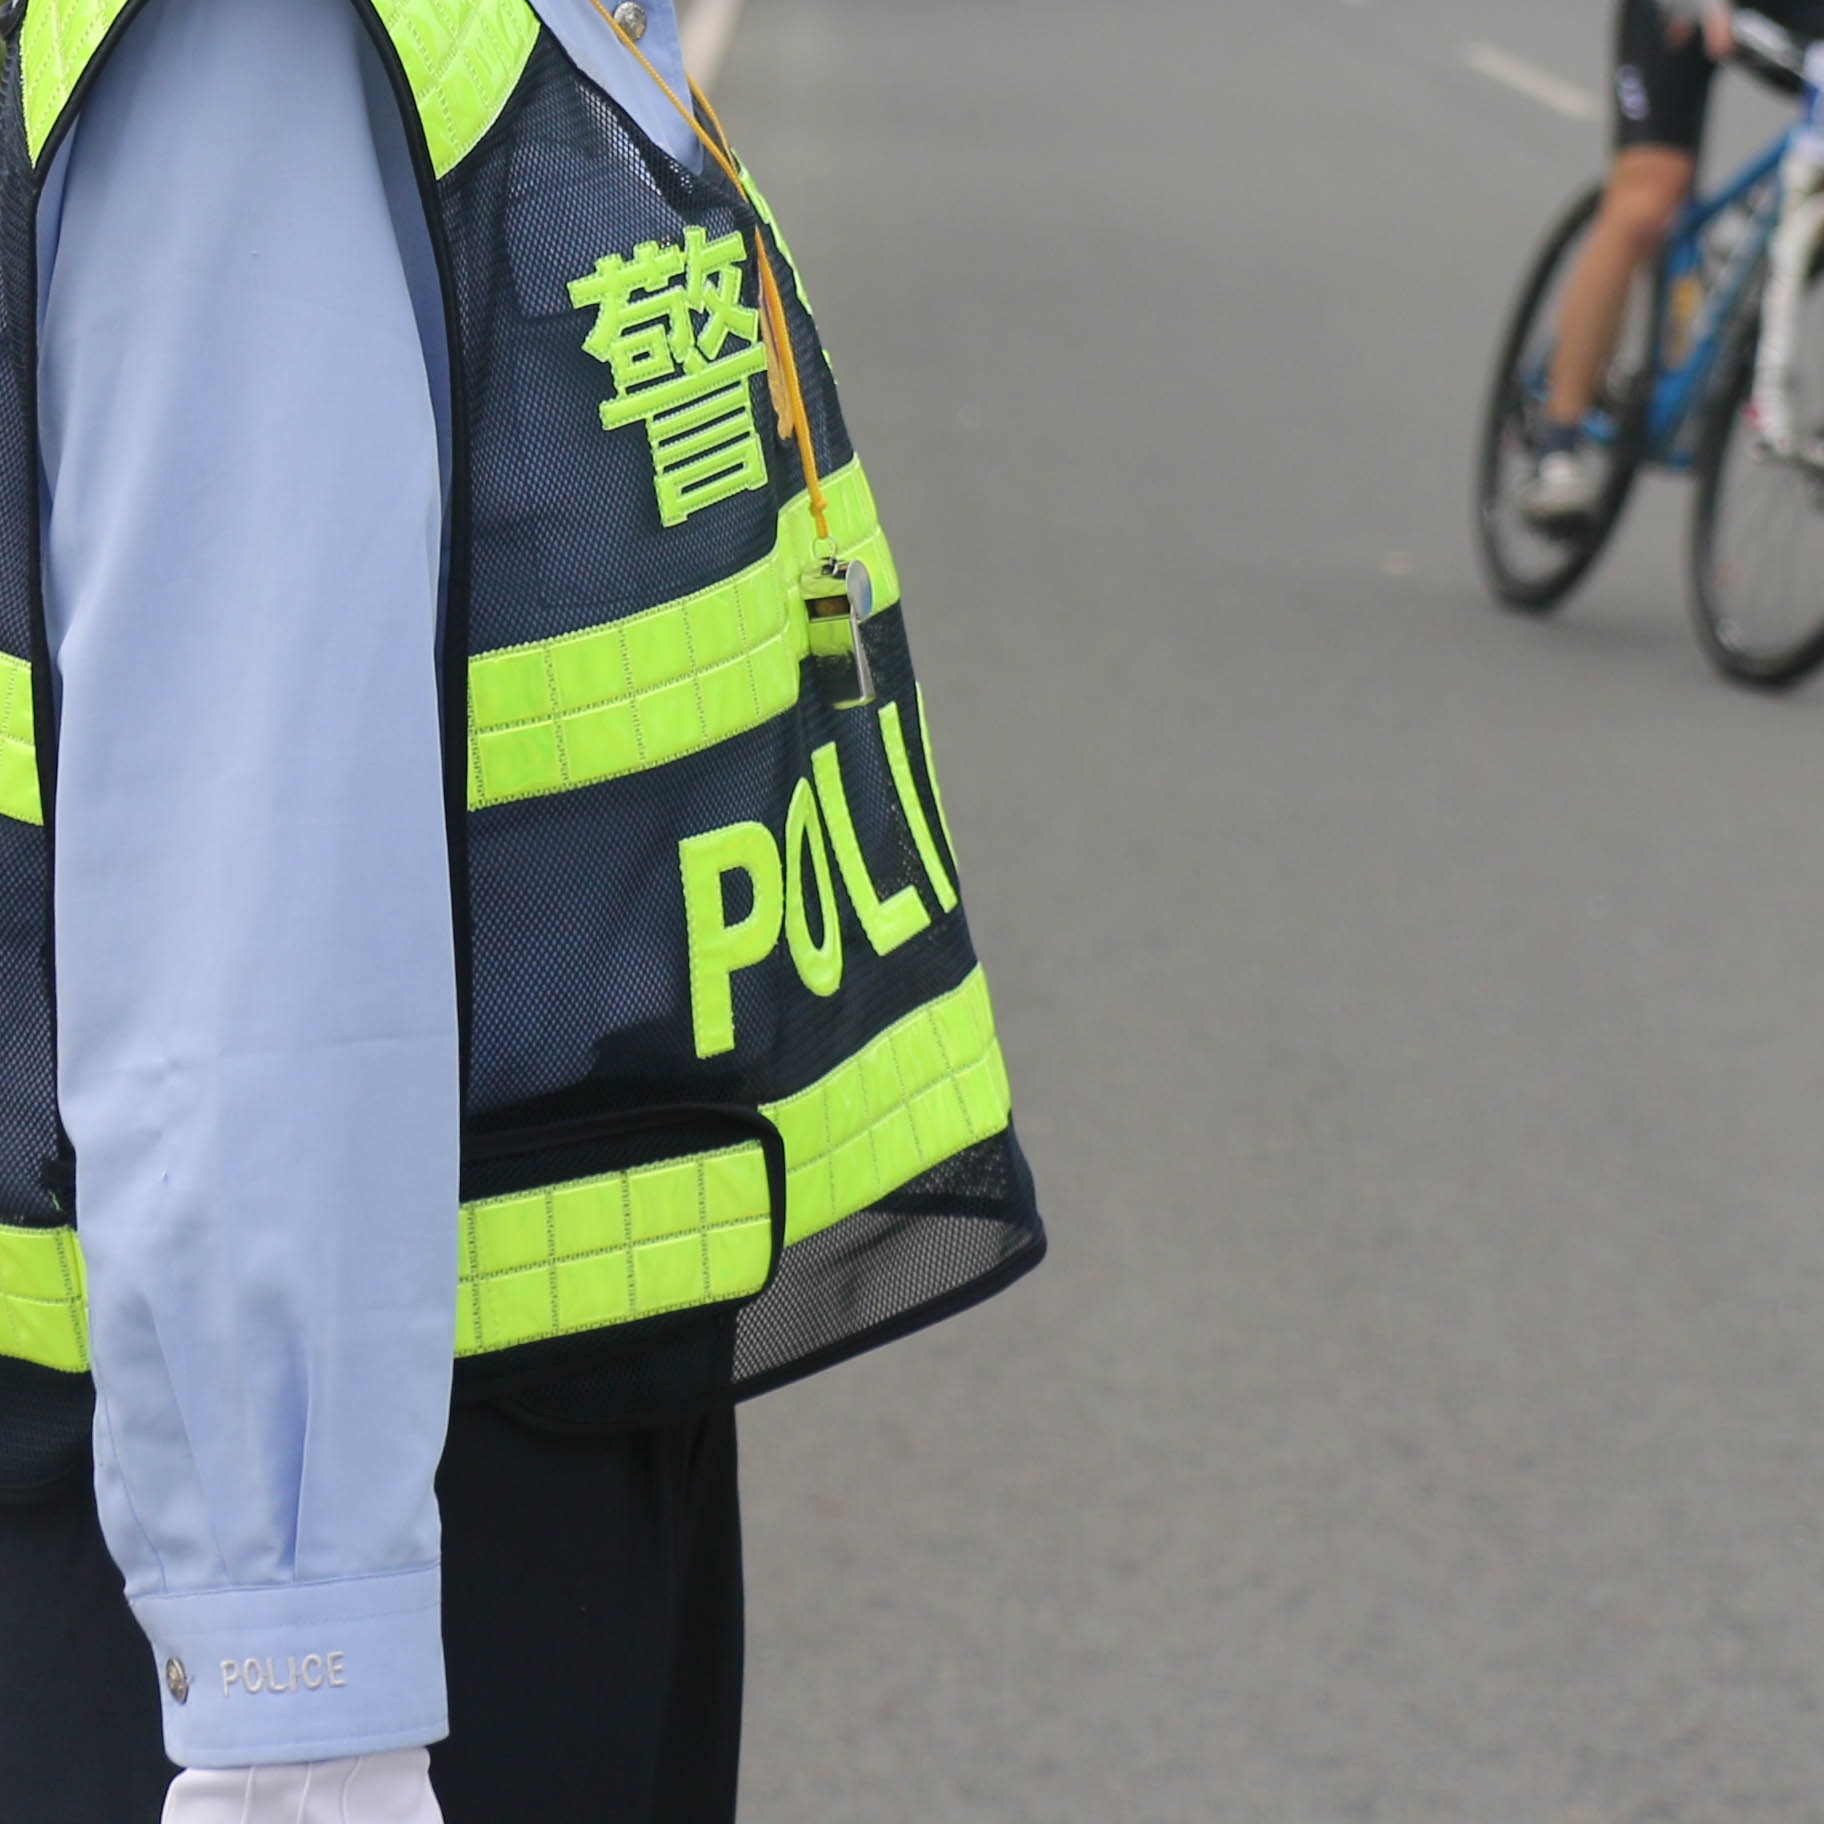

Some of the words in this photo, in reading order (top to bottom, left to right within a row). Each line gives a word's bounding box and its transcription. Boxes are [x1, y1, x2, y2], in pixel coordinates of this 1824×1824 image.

[567, 225, 768, 527] 警
[678, 682, 959, 1059] POLI
[220, 1651, 347, 1696] POLICE
